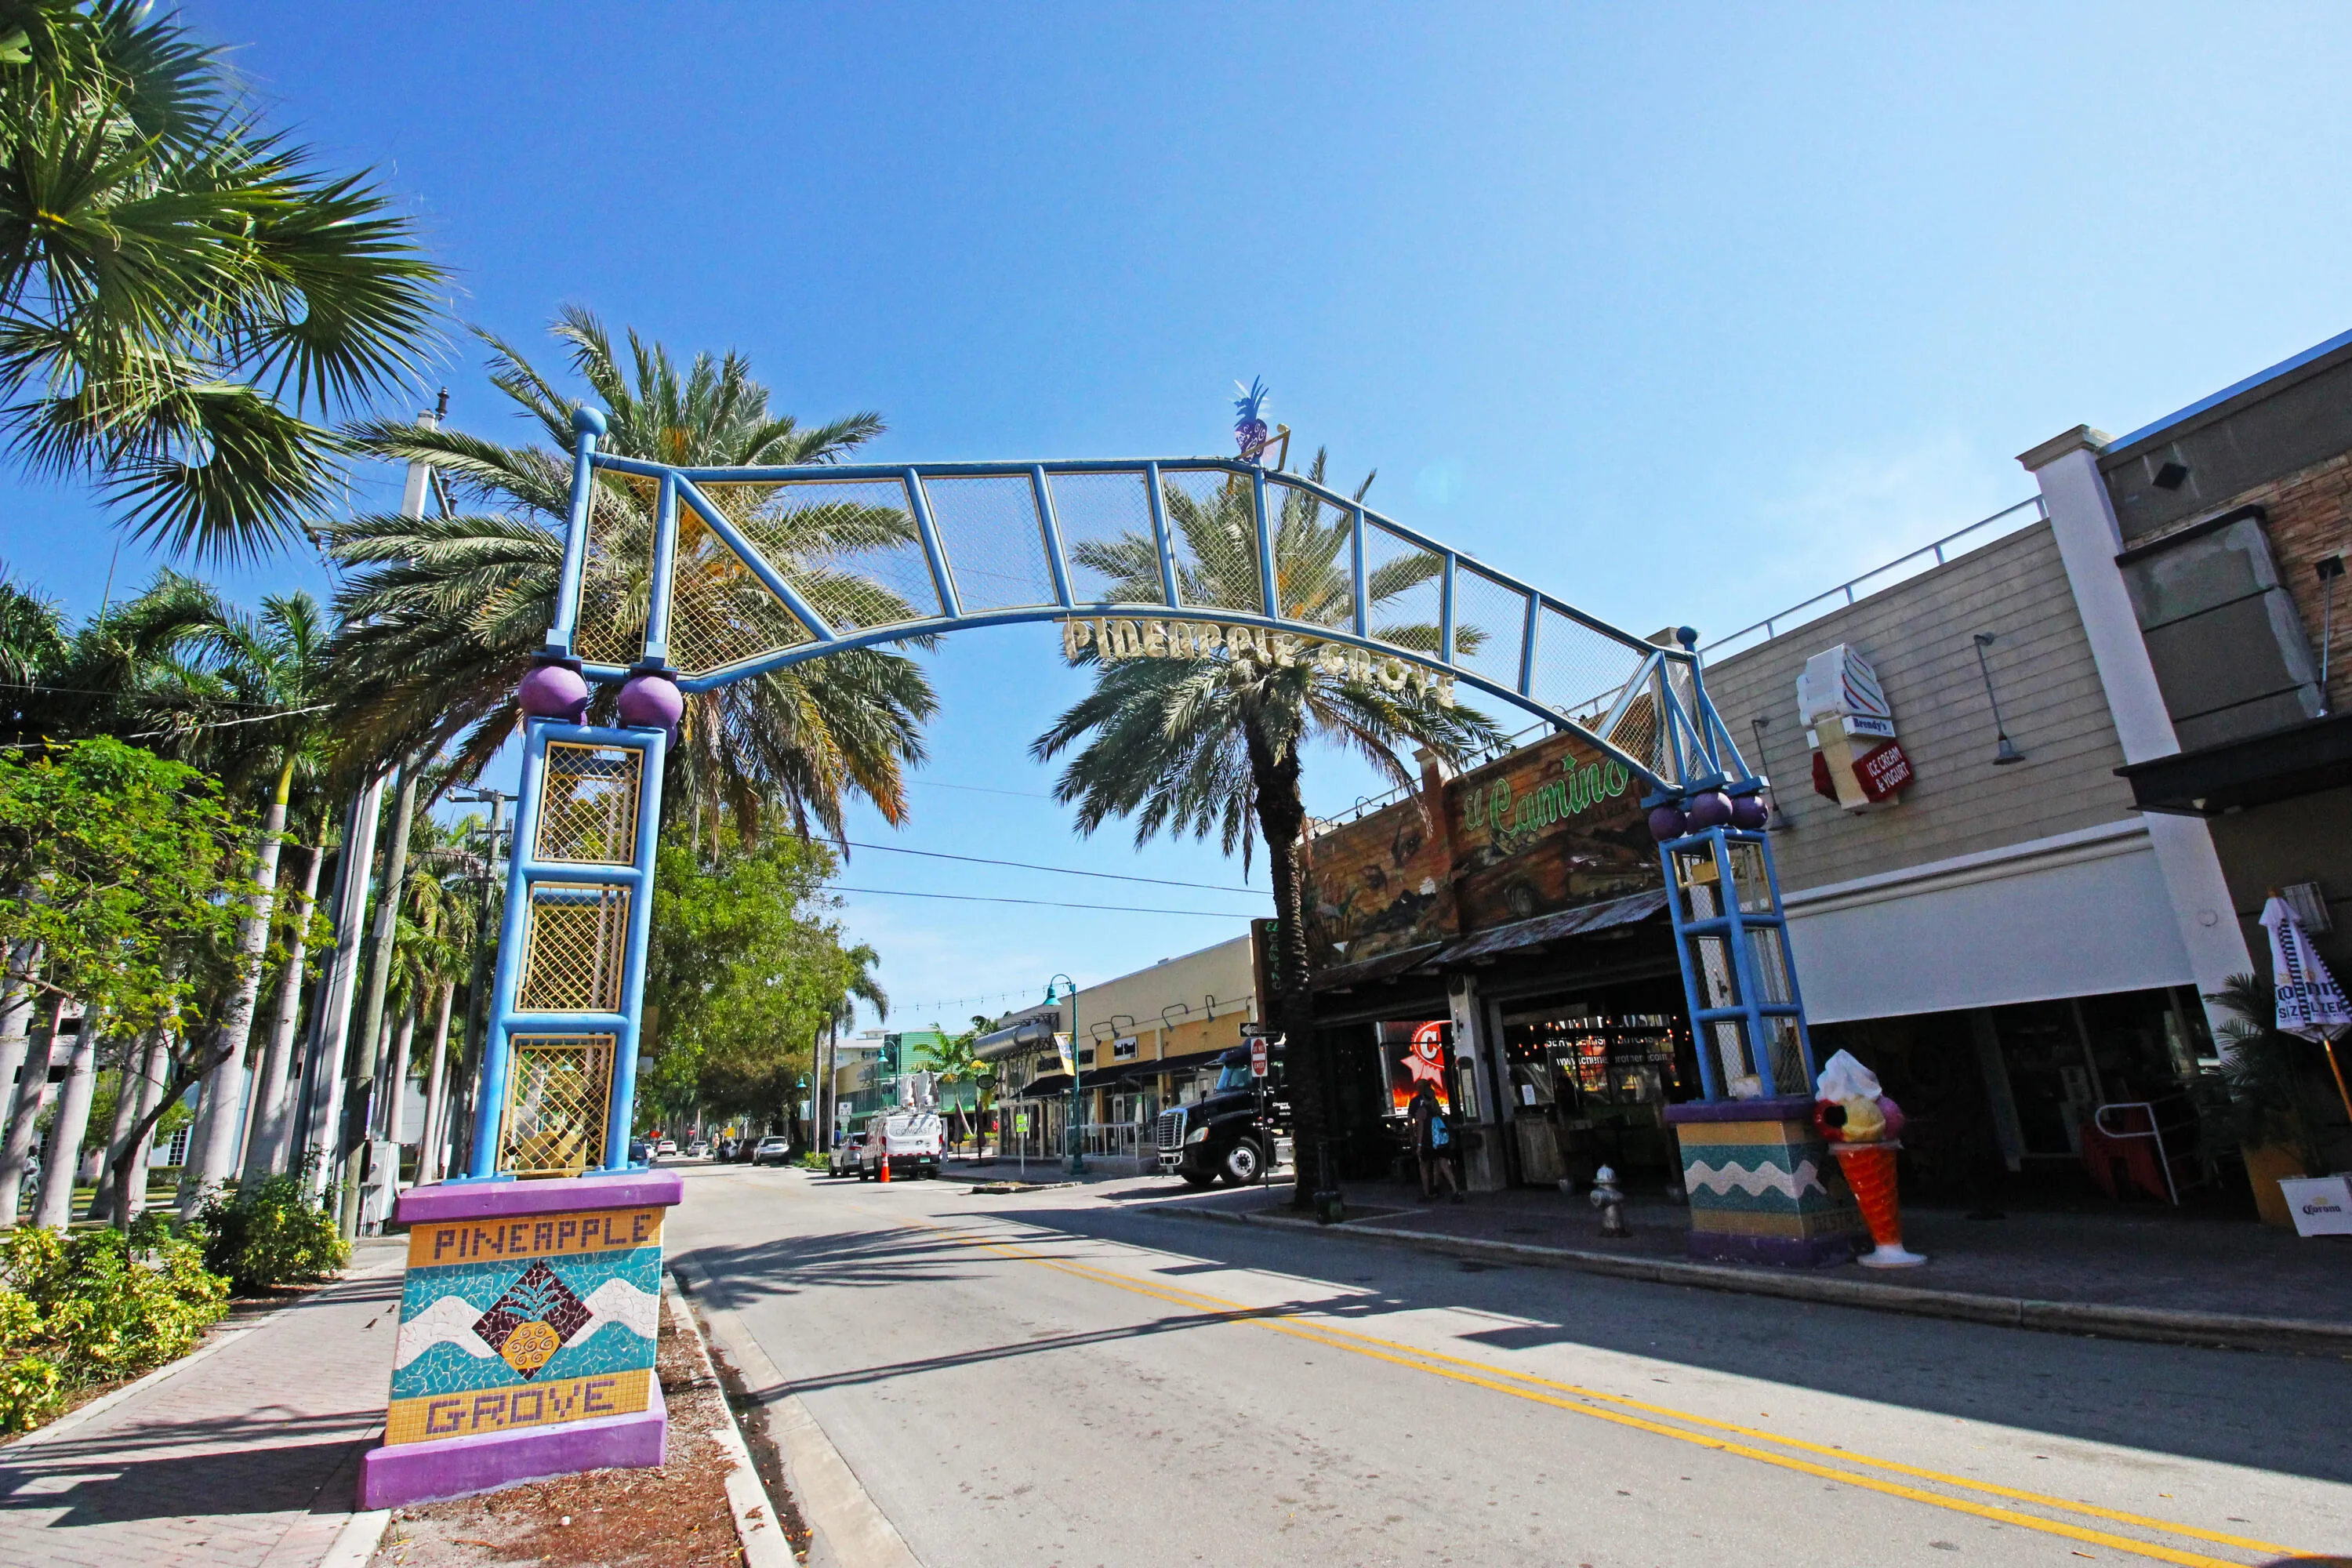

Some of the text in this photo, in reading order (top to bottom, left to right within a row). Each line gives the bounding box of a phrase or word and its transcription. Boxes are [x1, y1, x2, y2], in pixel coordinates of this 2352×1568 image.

[1319, 643, 1455, 710] GROVE
[1853, 717, 1887, 732] Brendy's
[1867, 746, 1903, 777] ICE CREAM
[1875, 761, 1910, 793] & YOGURT
[1463, 788, 1485, 832] El
[1490, 753, 1629, 840] Camino
[895, 1127, 931, 1136] COMCAST
[2303, 1205, 2342, 1215] Corona
[434, 1214, 652, 1259] PINEAPPLE
[426, 1380, 616, 1435] GROVE
